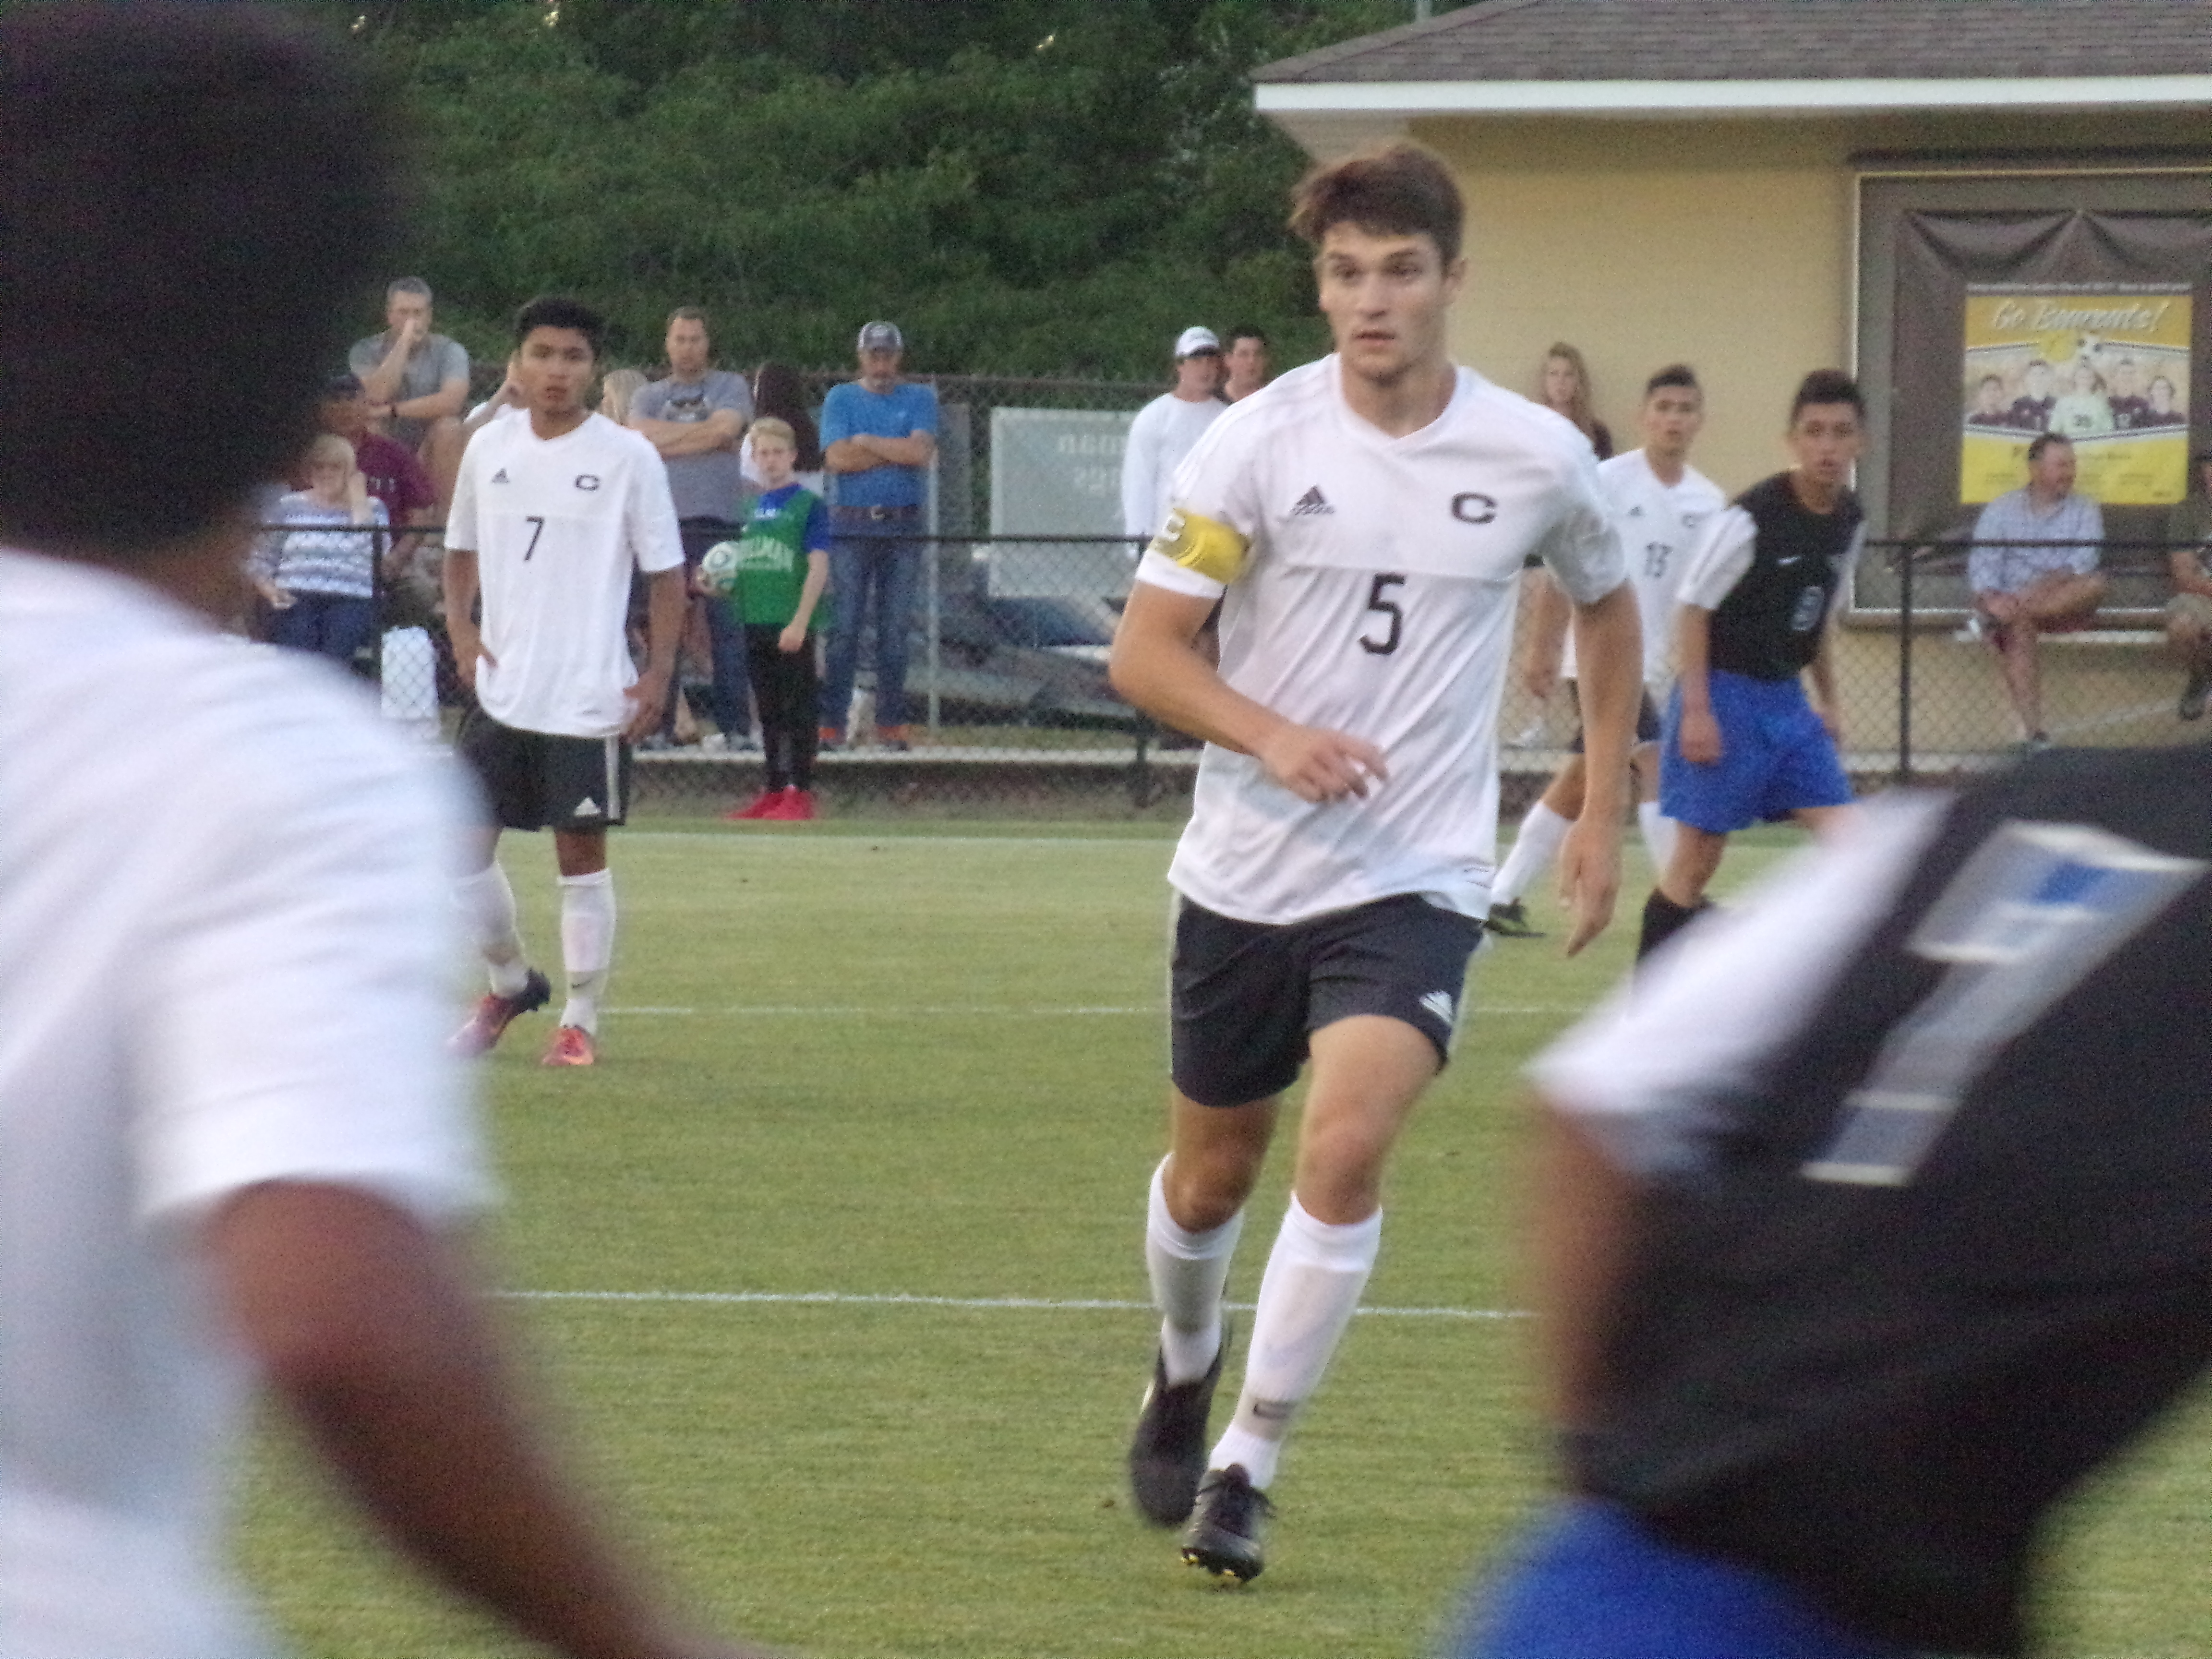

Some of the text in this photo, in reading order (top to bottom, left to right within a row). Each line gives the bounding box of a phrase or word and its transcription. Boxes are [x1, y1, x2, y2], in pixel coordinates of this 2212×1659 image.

[576, 474, 600, 491] C
[1451, 492, 1496, 523] C
[524, 516, 544, 560] 7
[1358, 573, 1406, 655] 5
